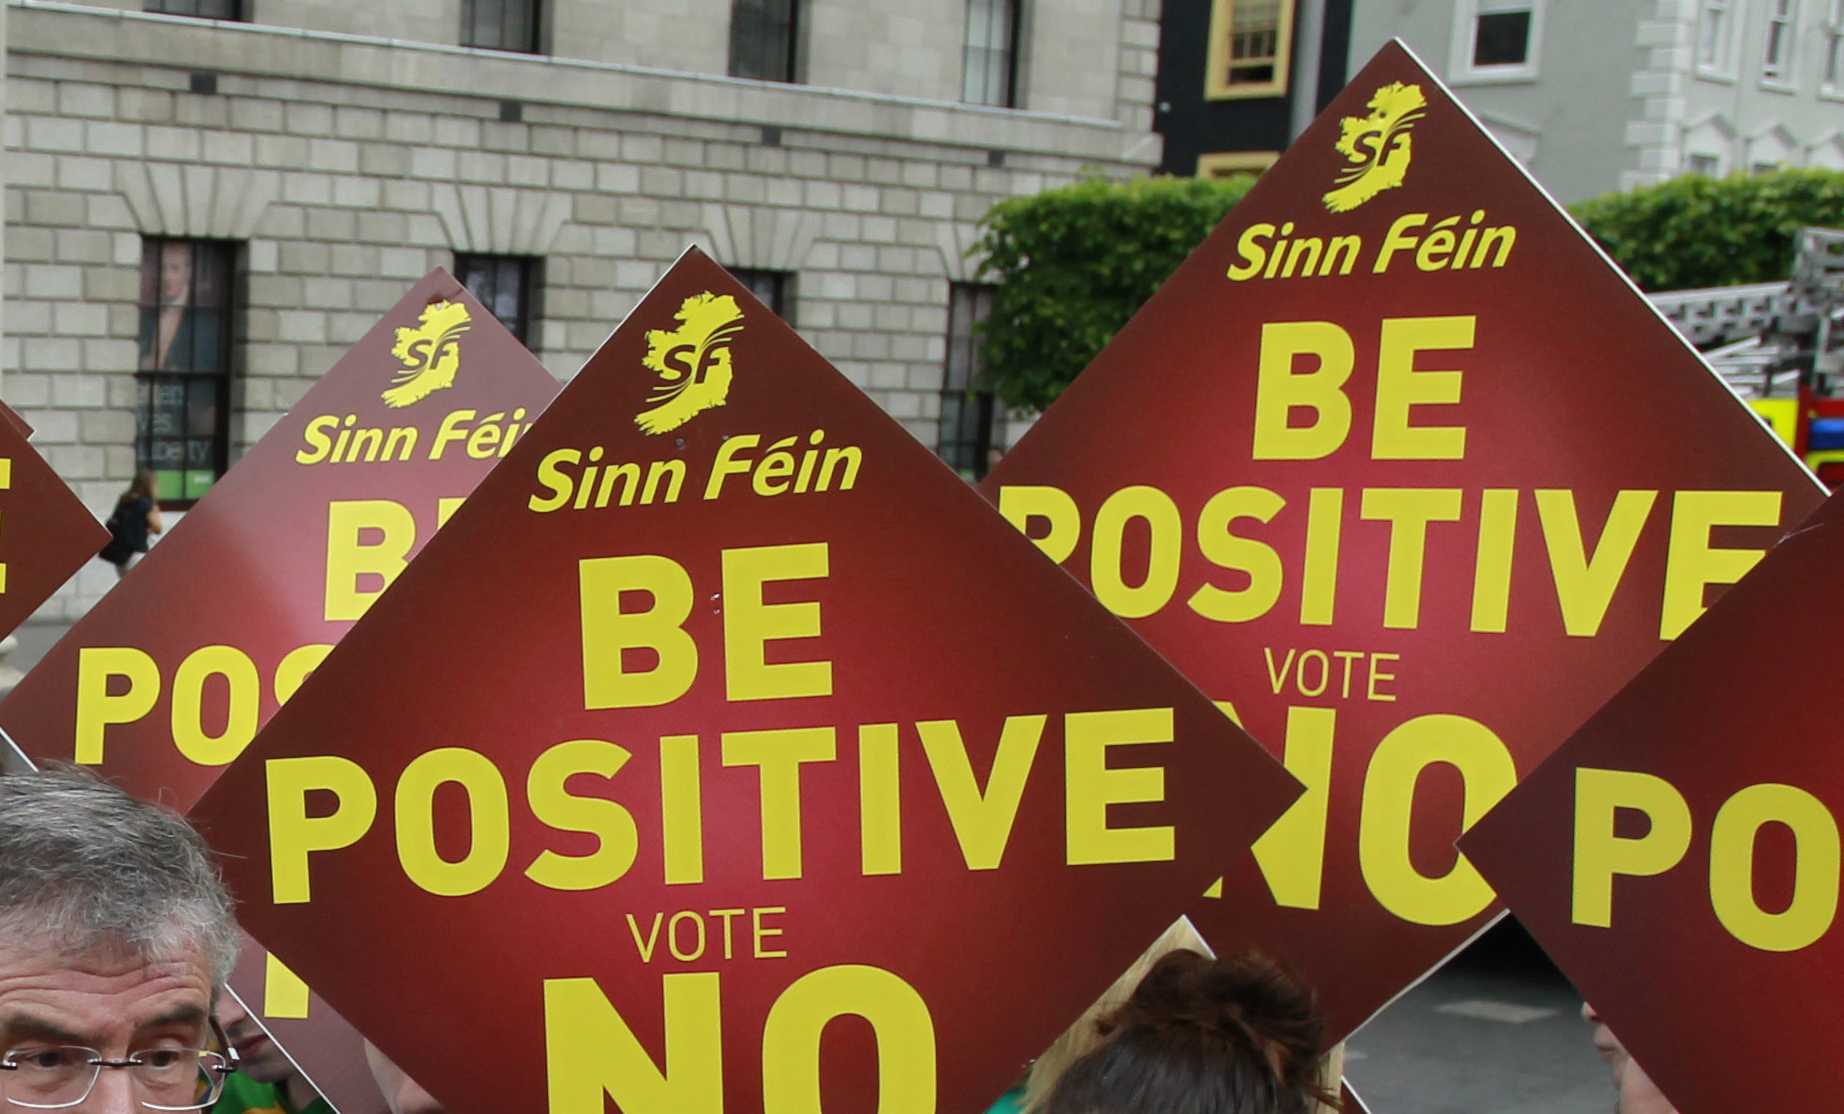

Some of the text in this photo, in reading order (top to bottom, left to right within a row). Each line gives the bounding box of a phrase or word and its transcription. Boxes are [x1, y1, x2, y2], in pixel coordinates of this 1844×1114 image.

[1227, 210, 1518, 282] Sinn Féin
[1251, 315, 1477, 461] BE
[296, 408, 534, 467] Sinn Féi
[528, 431, 863, 513] Sinn Féin
[323, 499, 471, 623] B
[578, 542, 833, 710] BE
[1264, 647, 1400, 702] VOTE
[265, 707, 1176, 904] POSITIVE
[625, 906, 788, 963] VOTE
